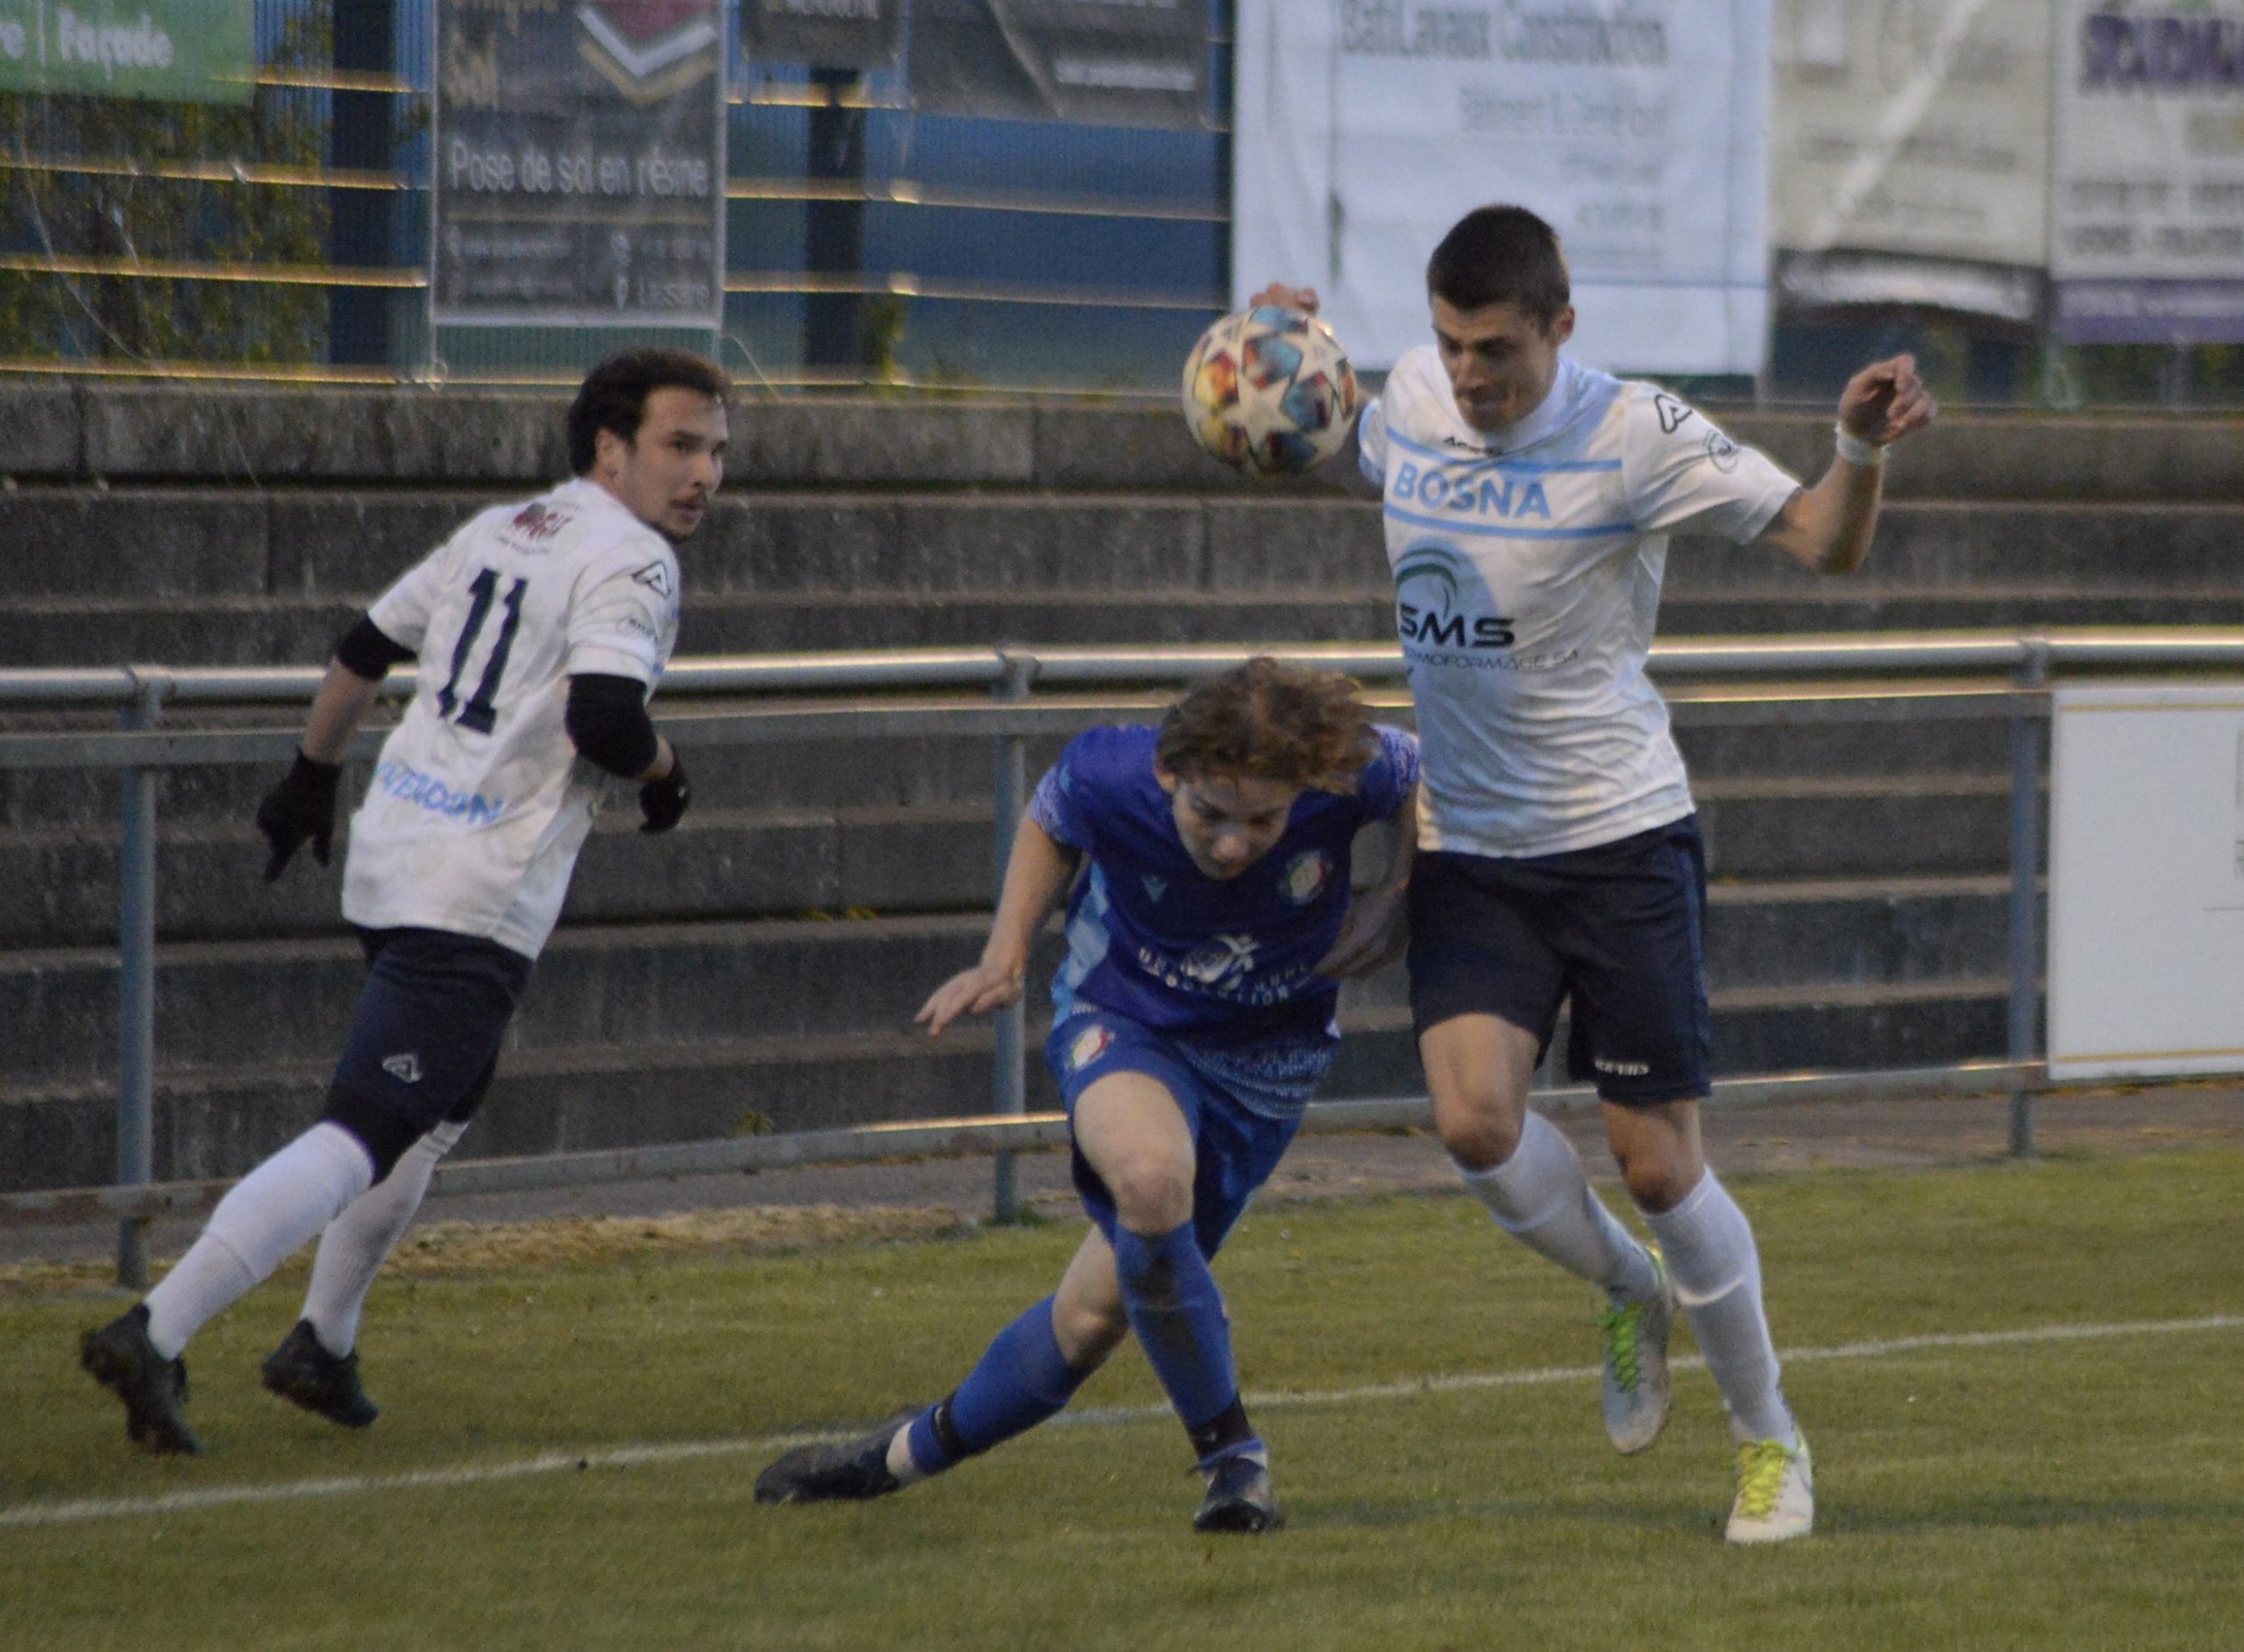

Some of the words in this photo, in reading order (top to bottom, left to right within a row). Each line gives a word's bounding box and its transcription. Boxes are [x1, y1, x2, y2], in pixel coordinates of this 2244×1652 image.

[451, 137, 517, 193] Pose
[523, 139, 552, 194] de
[557, 141, 594, 195] sol
[599, 155, 632, 196] en
[1393, 462, 1552, 521] BOSNA
[437, 567, 529, 736] 11
[1399, 605, 1516, 649] SMS
